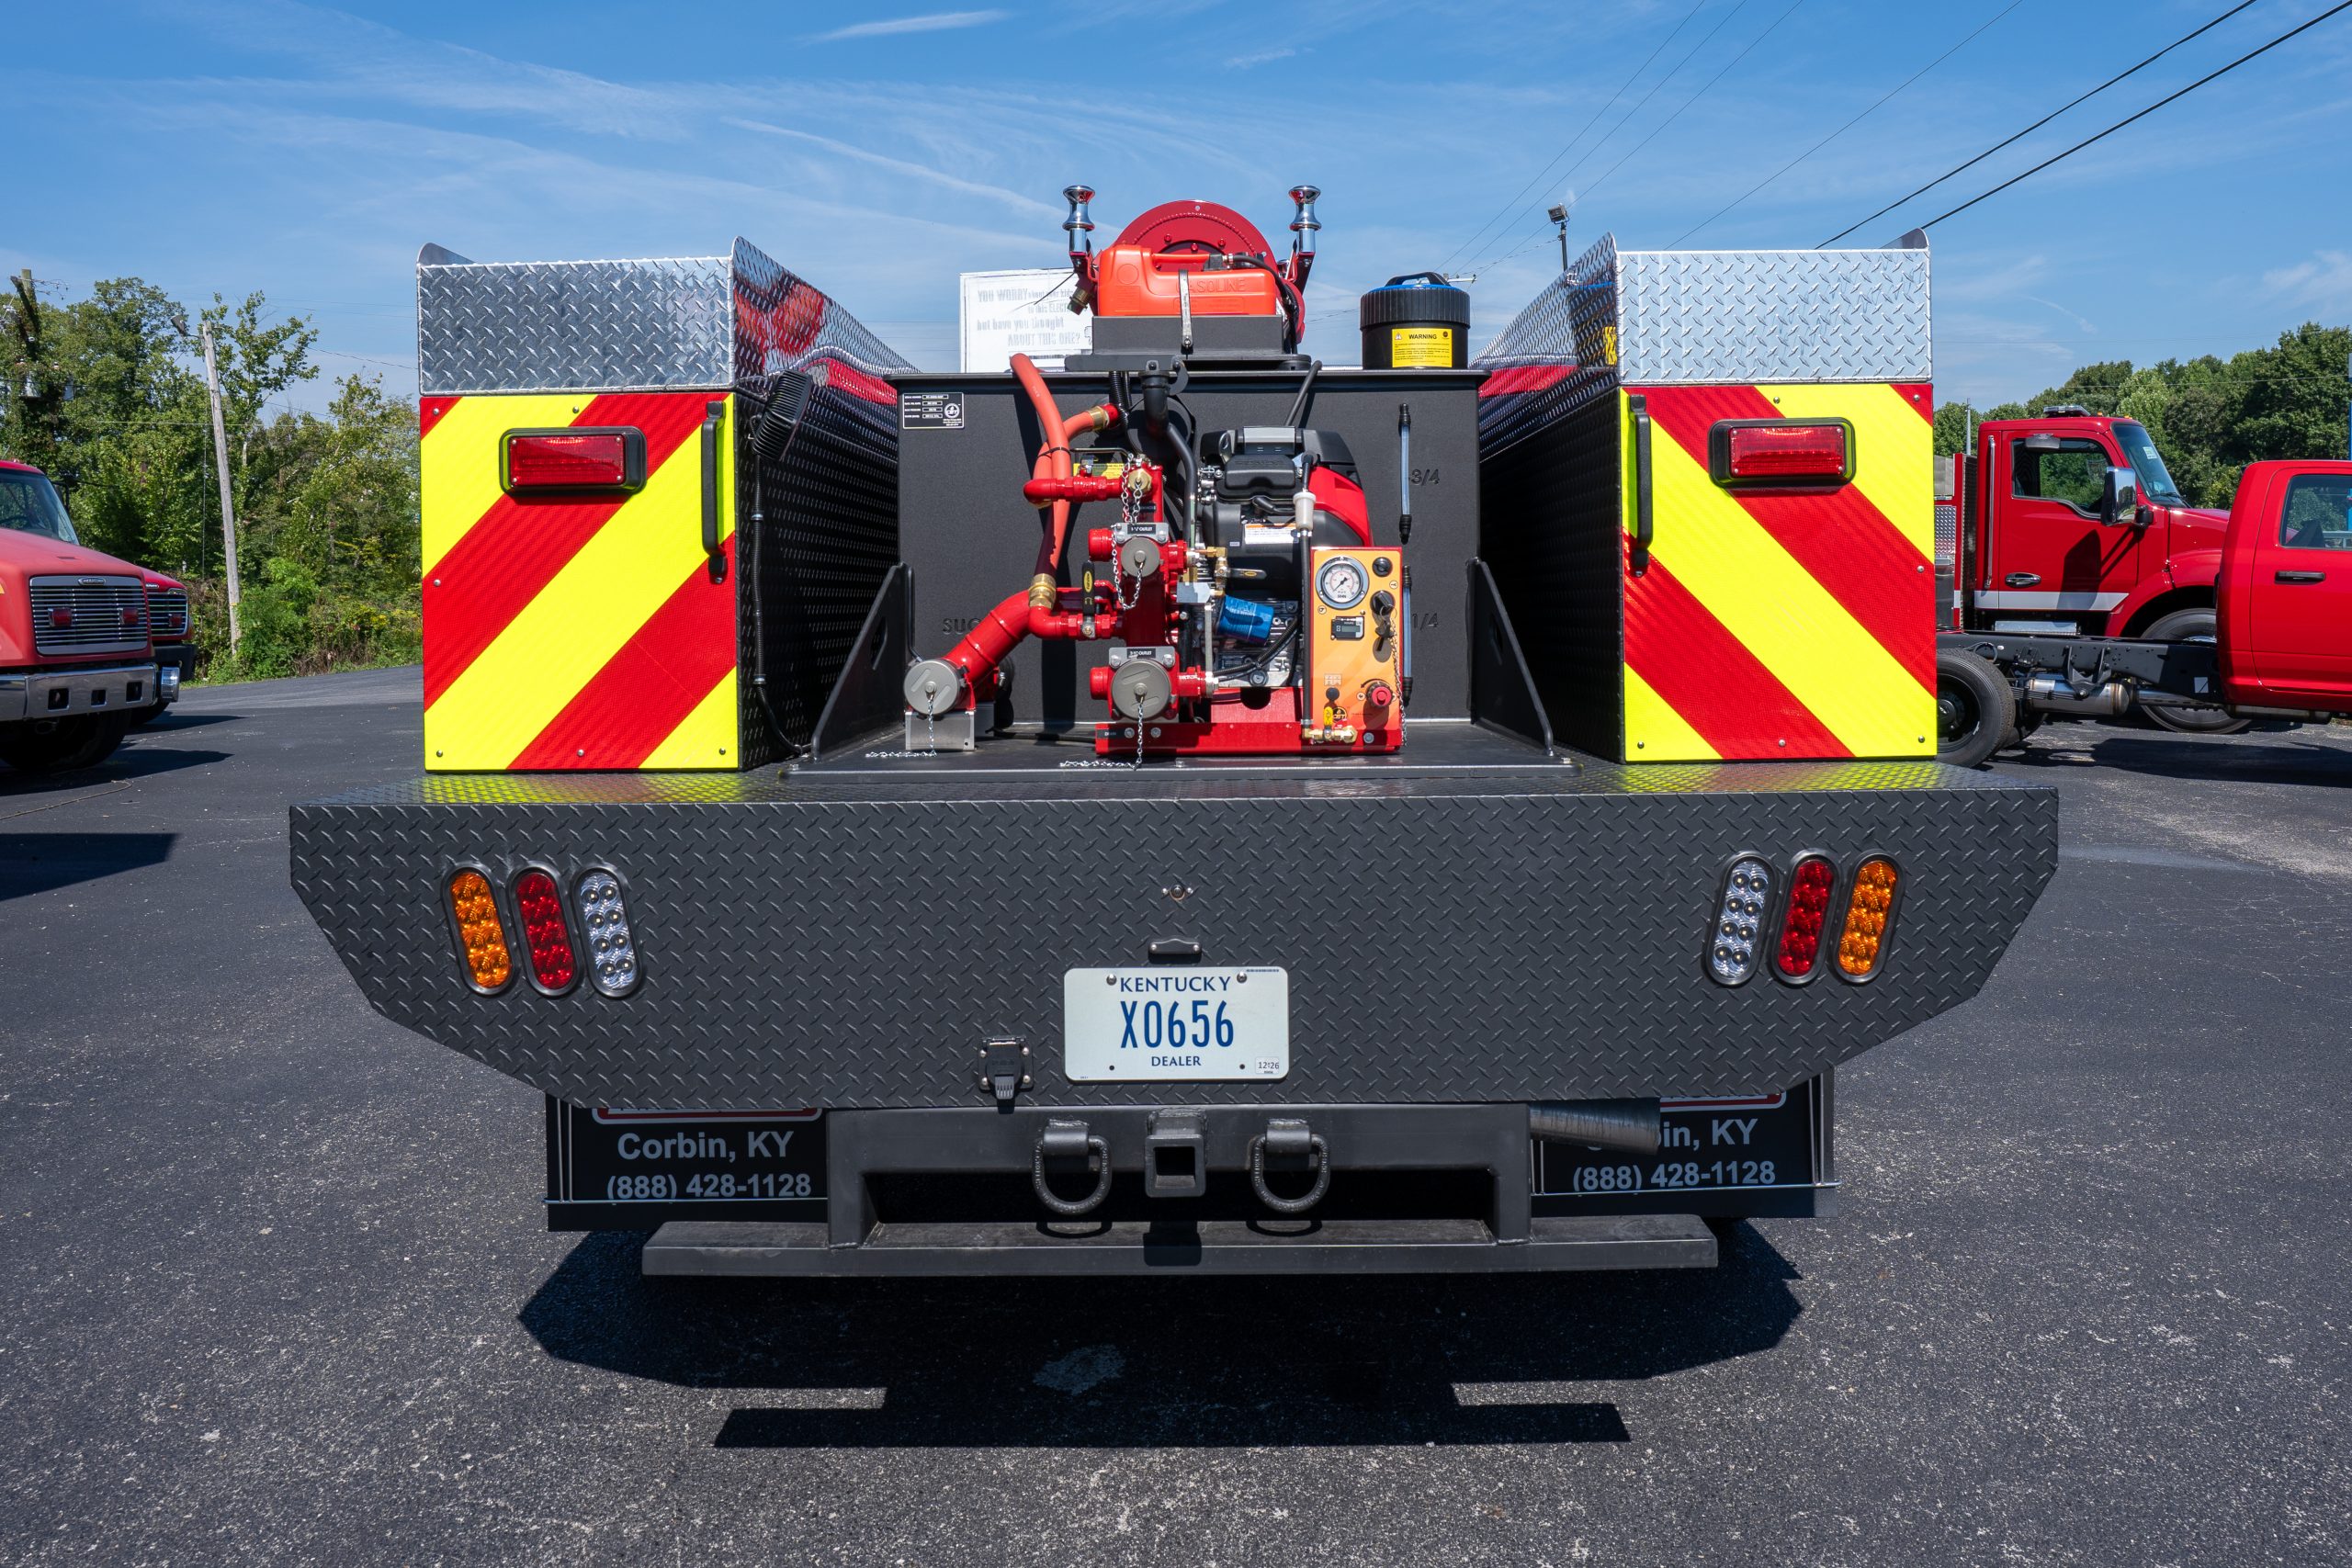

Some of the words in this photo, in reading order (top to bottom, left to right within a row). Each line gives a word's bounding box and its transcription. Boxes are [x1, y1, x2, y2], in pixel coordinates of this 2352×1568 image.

[978, 289, 994, 302] YOU
[997, 288, 1028, 301] WORRY
[977, 320, 990, 331] but
[992, 319, 1012, 330] have
[1014, 319, 1029, 332] you
[1032, 316, 1064, 331] thought
[1008, 333, 1035, 346] ABOUT
[1038, 333, 1057, 345] THIS
[1058, 332, 1080, 344] ONE?
[1411, 468, 1441, 487] 3/4
[1411, 612, 1439, 632] 1/4
[1120, 976, 1231, 992] KENTUCKY
[1120, 999, 1234, 1048] X0656
[1151, 1055, 1202, 1066] DEALER
[1712, 1118, 1758, 1145] KY
[617, 1132, 736, 1163] Corbin,
[747, 1131, 795, 1158] KY
[1573, 1165, 1643, 1193] (888)
[1650, 1160, 1776, 1188] 428-1128
[607, 1174, 677, 1201] (888)
[685, 1173, 812, 1198] 428-1128
